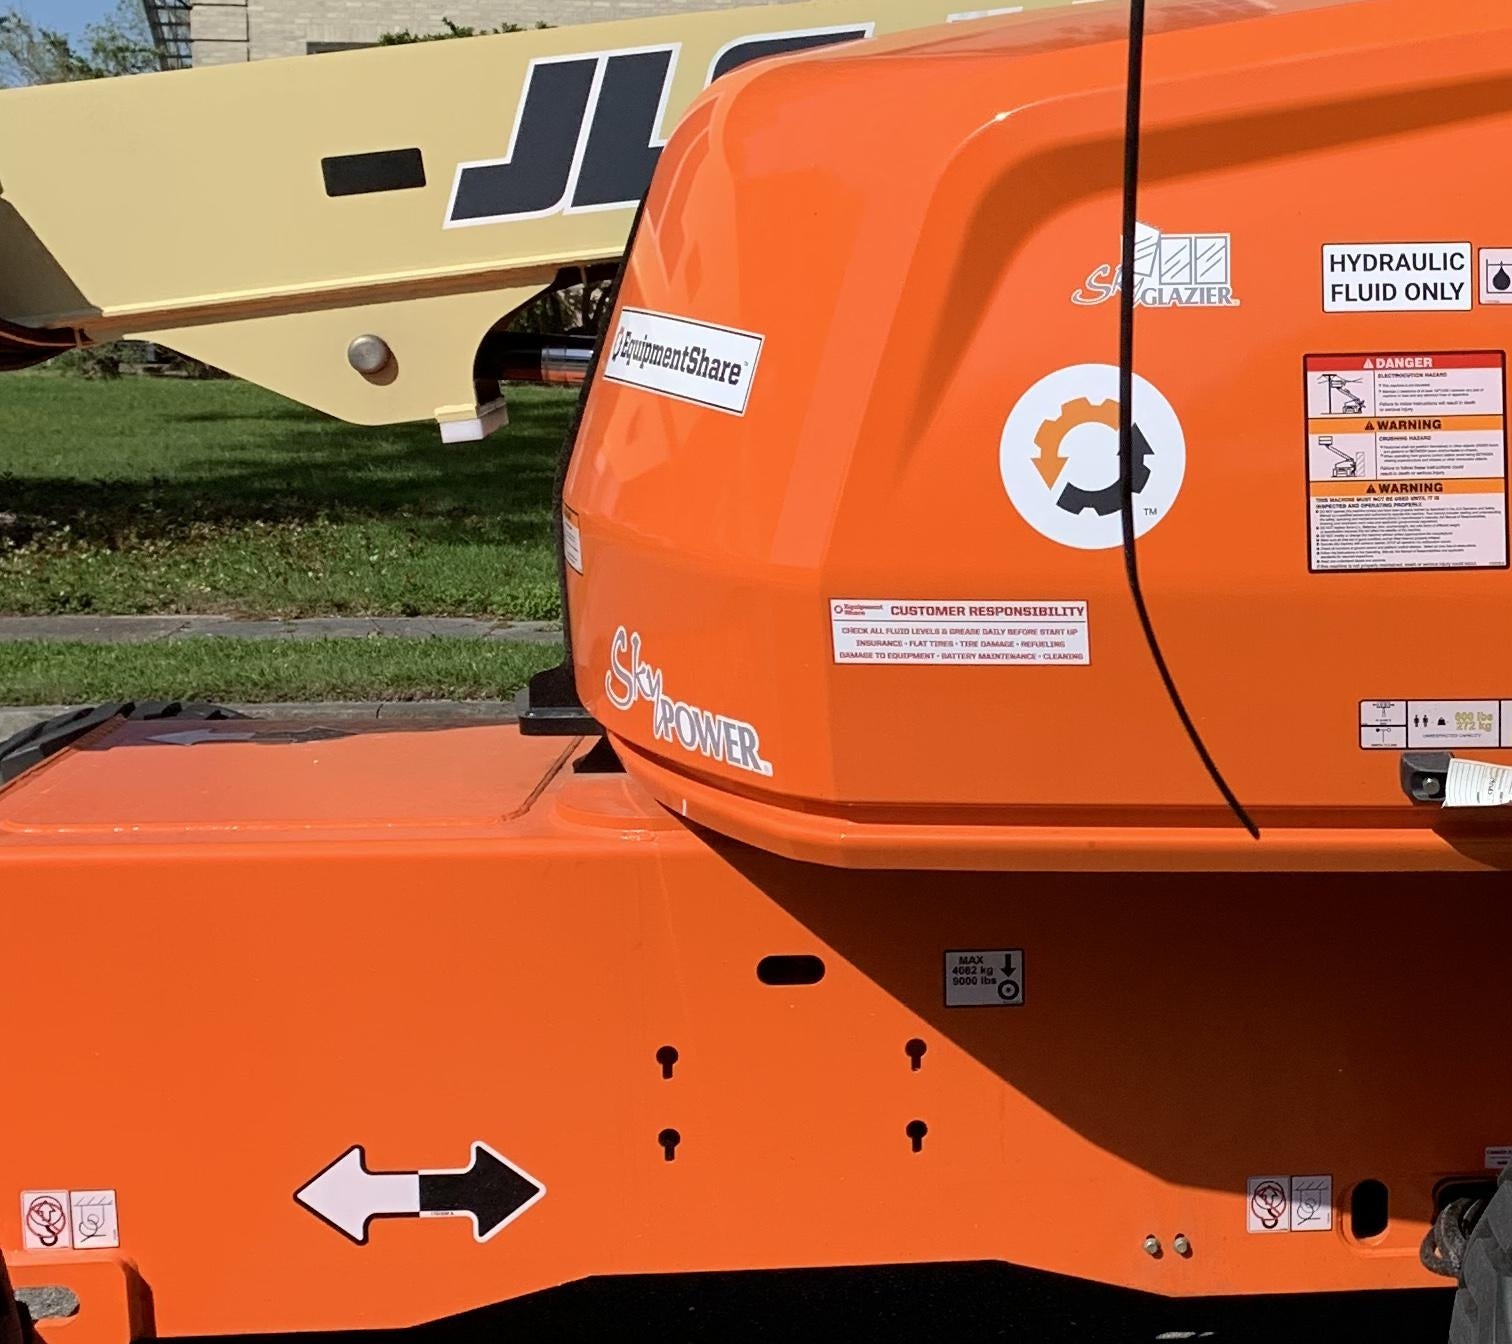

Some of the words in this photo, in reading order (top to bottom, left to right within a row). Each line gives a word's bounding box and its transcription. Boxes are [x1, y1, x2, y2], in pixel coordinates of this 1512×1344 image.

[443, 22, 876, 229] JL
[1330, 252, 1465, 273] HYDRAULIC
[1331, 283, 1397, 302] FLUID
[1405, 282, 1465, 301] ONLY
[620, 331, 742, 385] EquipmentShare
[1375, 357, 1433, 369] DANGER
[1377, 419, 1442, 431] WARNING
[1378, 482, 1443, 494] WARNING
[890, 605, 965, 617] CUSTOMER
[969, 606, 1084, 617] RESPONSIBILITY
[1007, 628, 1038, 636] BEFORE
[1040, 628, 1064, 636] START
[856, 639, 903, 647] INSURANCE
[941, 652, 976, 660] BATTERY
[1456, 721, 1476, 731] 272
[1478, 721, 1493, 732] kg
[959, 955, 984, 965] MAX
[952, 966, 977, 975] 4082
[980, 965, 994, 976] kg
[952, 976, 978, 986] 9000
[980, 976, 997, 985] lbs
